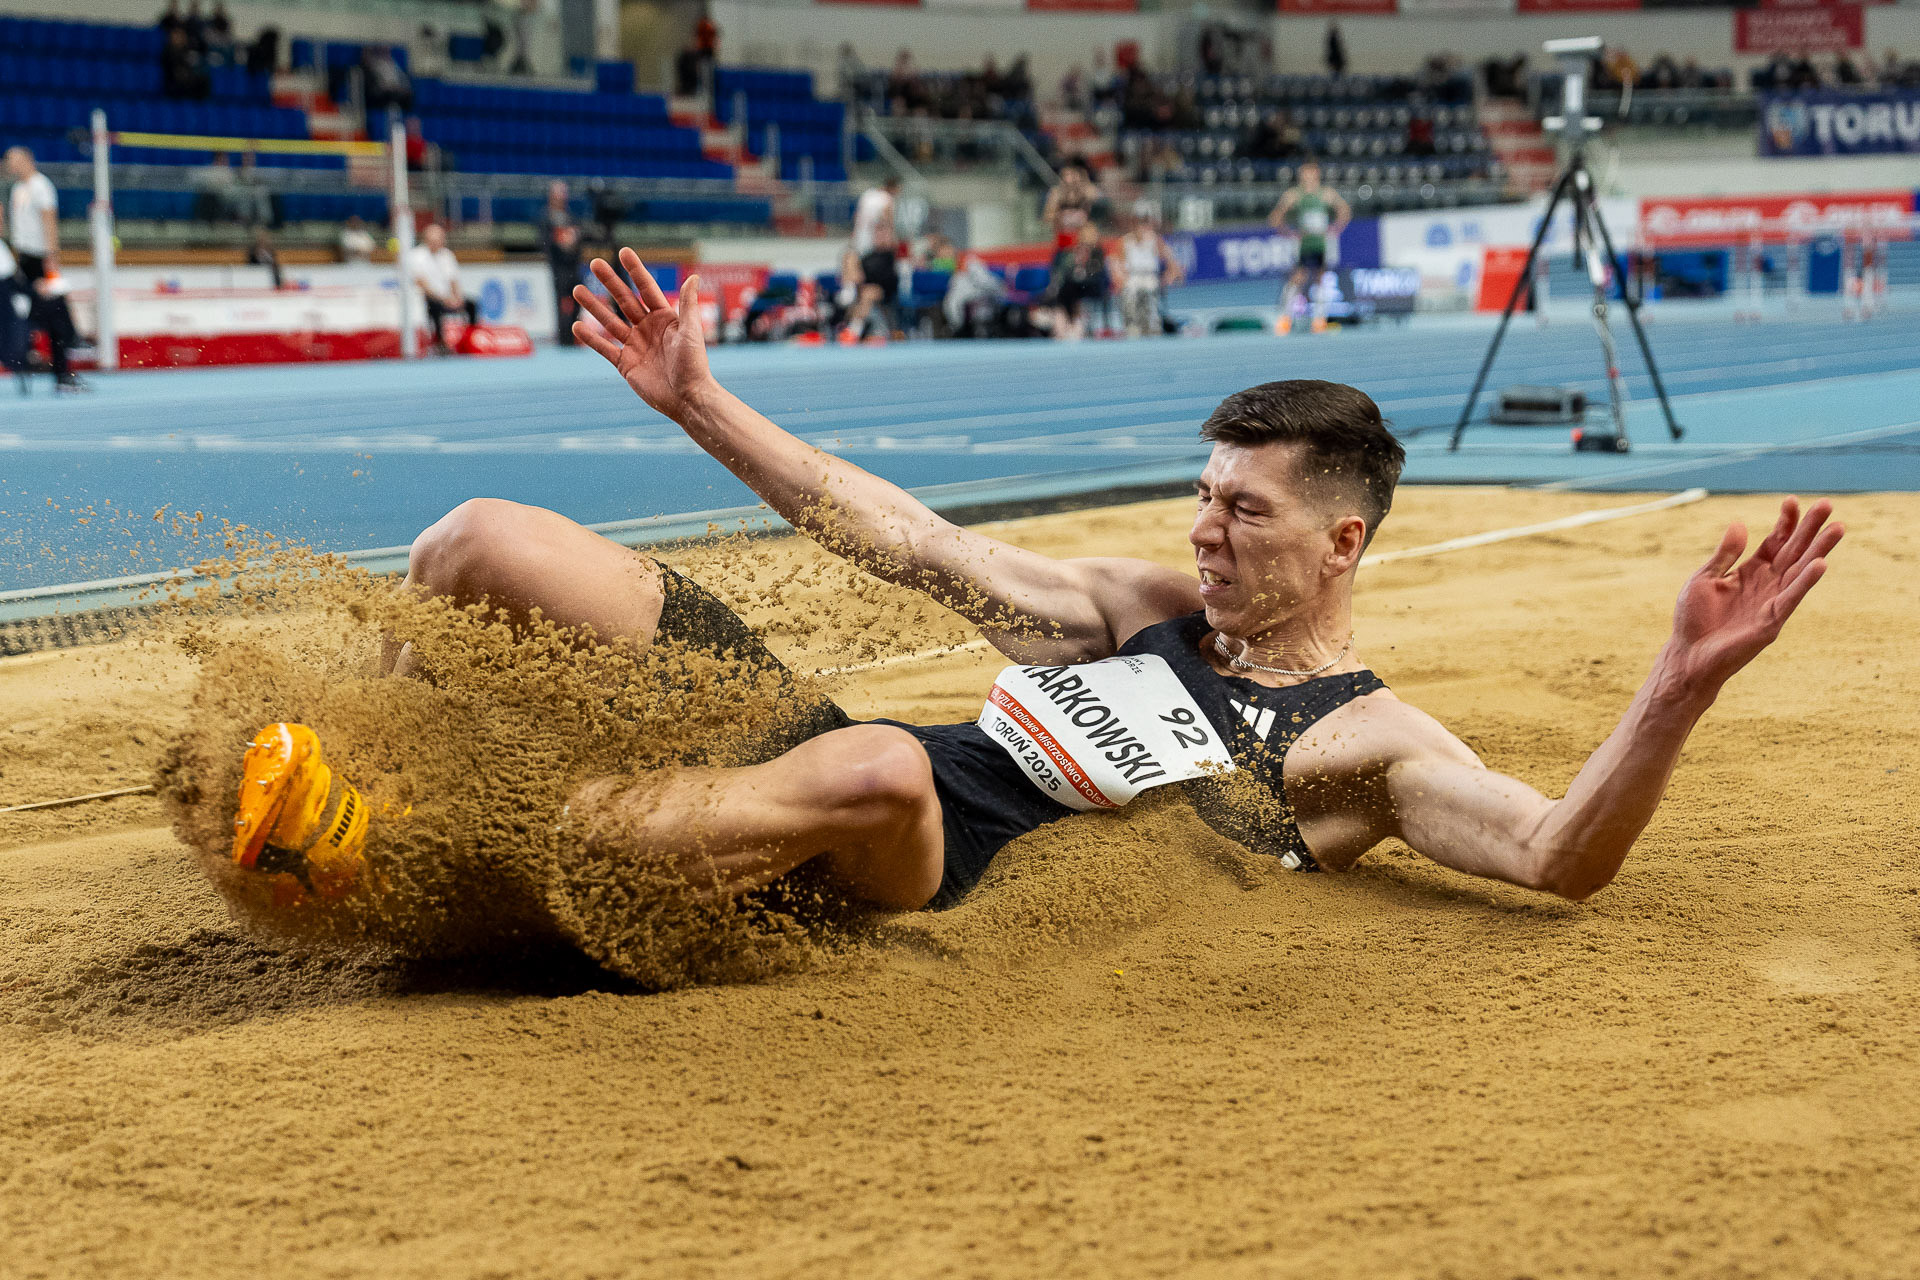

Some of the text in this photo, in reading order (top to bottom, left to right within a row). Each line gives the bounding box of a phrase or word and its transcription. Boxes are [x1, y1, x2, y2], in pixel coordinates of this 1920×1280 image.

[991, 716, 1062, 792] TORUŃ 2025
[999, 693, 1015, 710] PZLA
[1010, 704, 1040, 734] Halowe
[1036, 731, 1082, 784] Mistrzostwa
[1021, 666, 1167, 786] ARKOWSKI
[1158, 707, 1209, 749] 92
